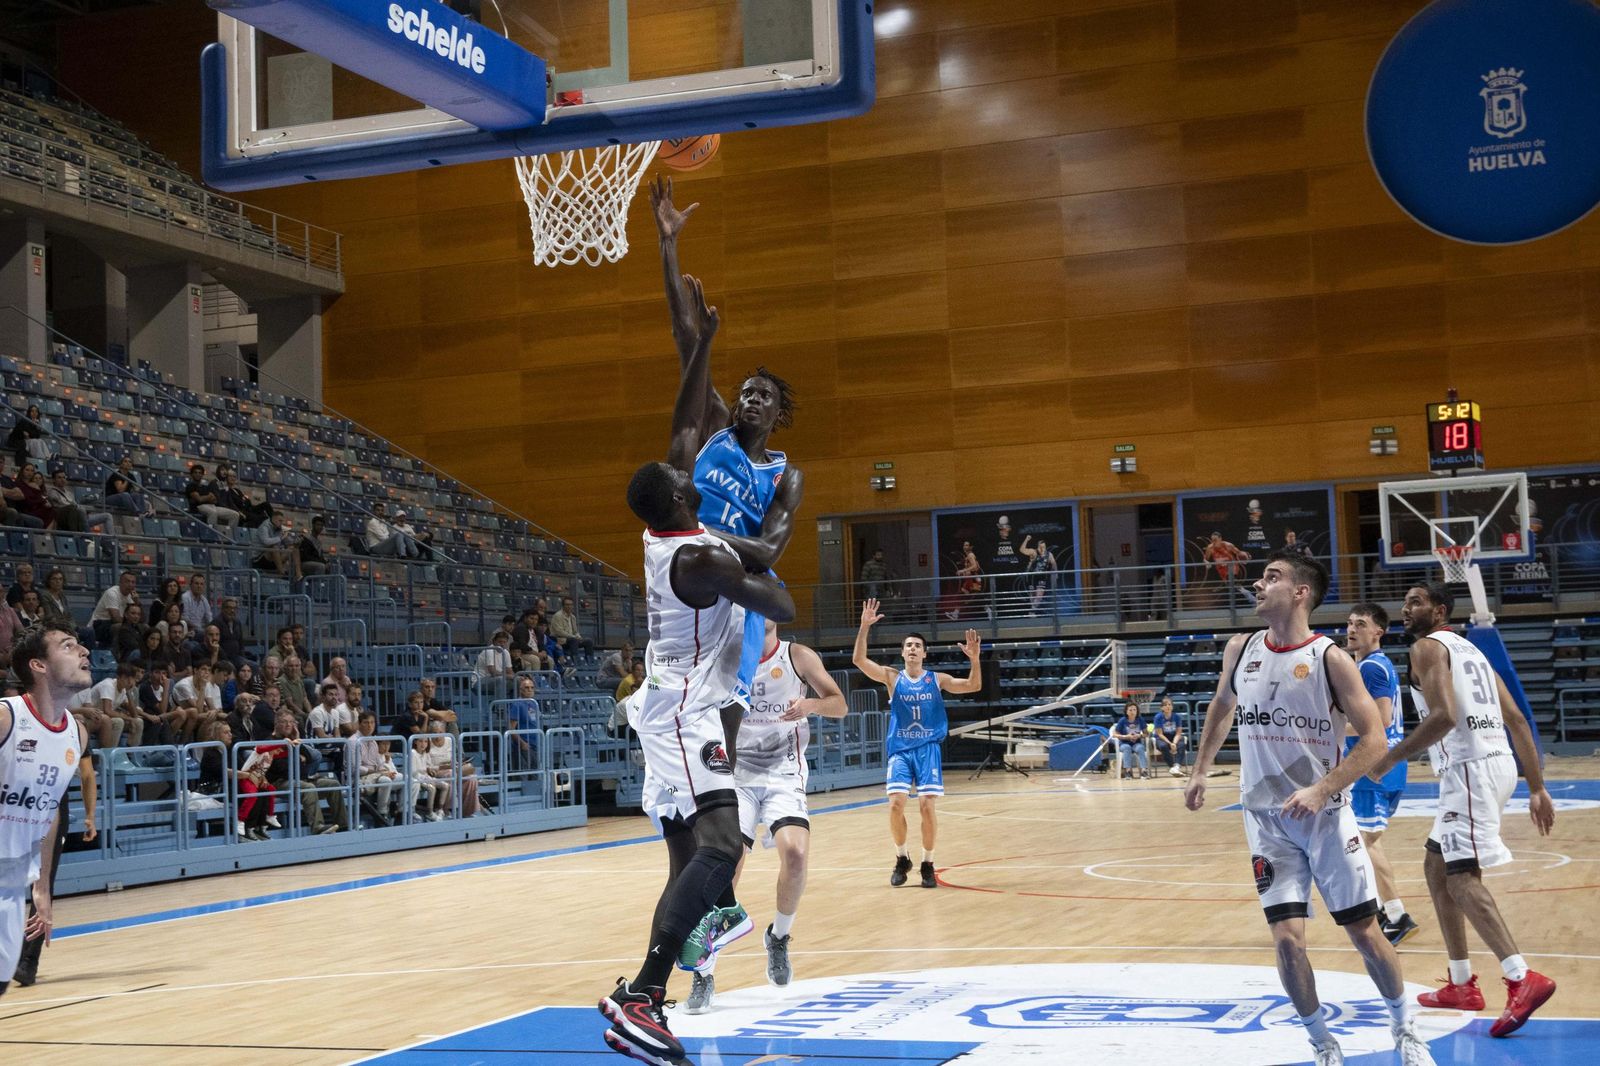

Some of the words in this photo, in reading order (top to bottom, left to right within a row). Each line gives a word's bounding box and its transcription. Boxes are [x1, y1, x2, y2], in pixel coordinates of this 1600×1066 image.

[387, 3, 486, 74] schelde
[1469, 142, 1532, 156] Ayuntamiento
[1533, 138, 1546, 148] de
[1468, 150, 1547, 172] HUELVA
[1438, 402, 1470, 420] 5:12
[1445, 422, 1468, 449] 18
[1514, 562, 1546, 572] COPA
[1269, 681, 1280, 701] 7
[1463, 660, 1496, 705] 31
[911, 705, 921, 720] 11
[1236, 704, 1332, 737] BieleGroup
[36, 764, 60, 787] 33
[1441, 833, 1461, 853] 31
[1356, 864, 1368, 890] 7
